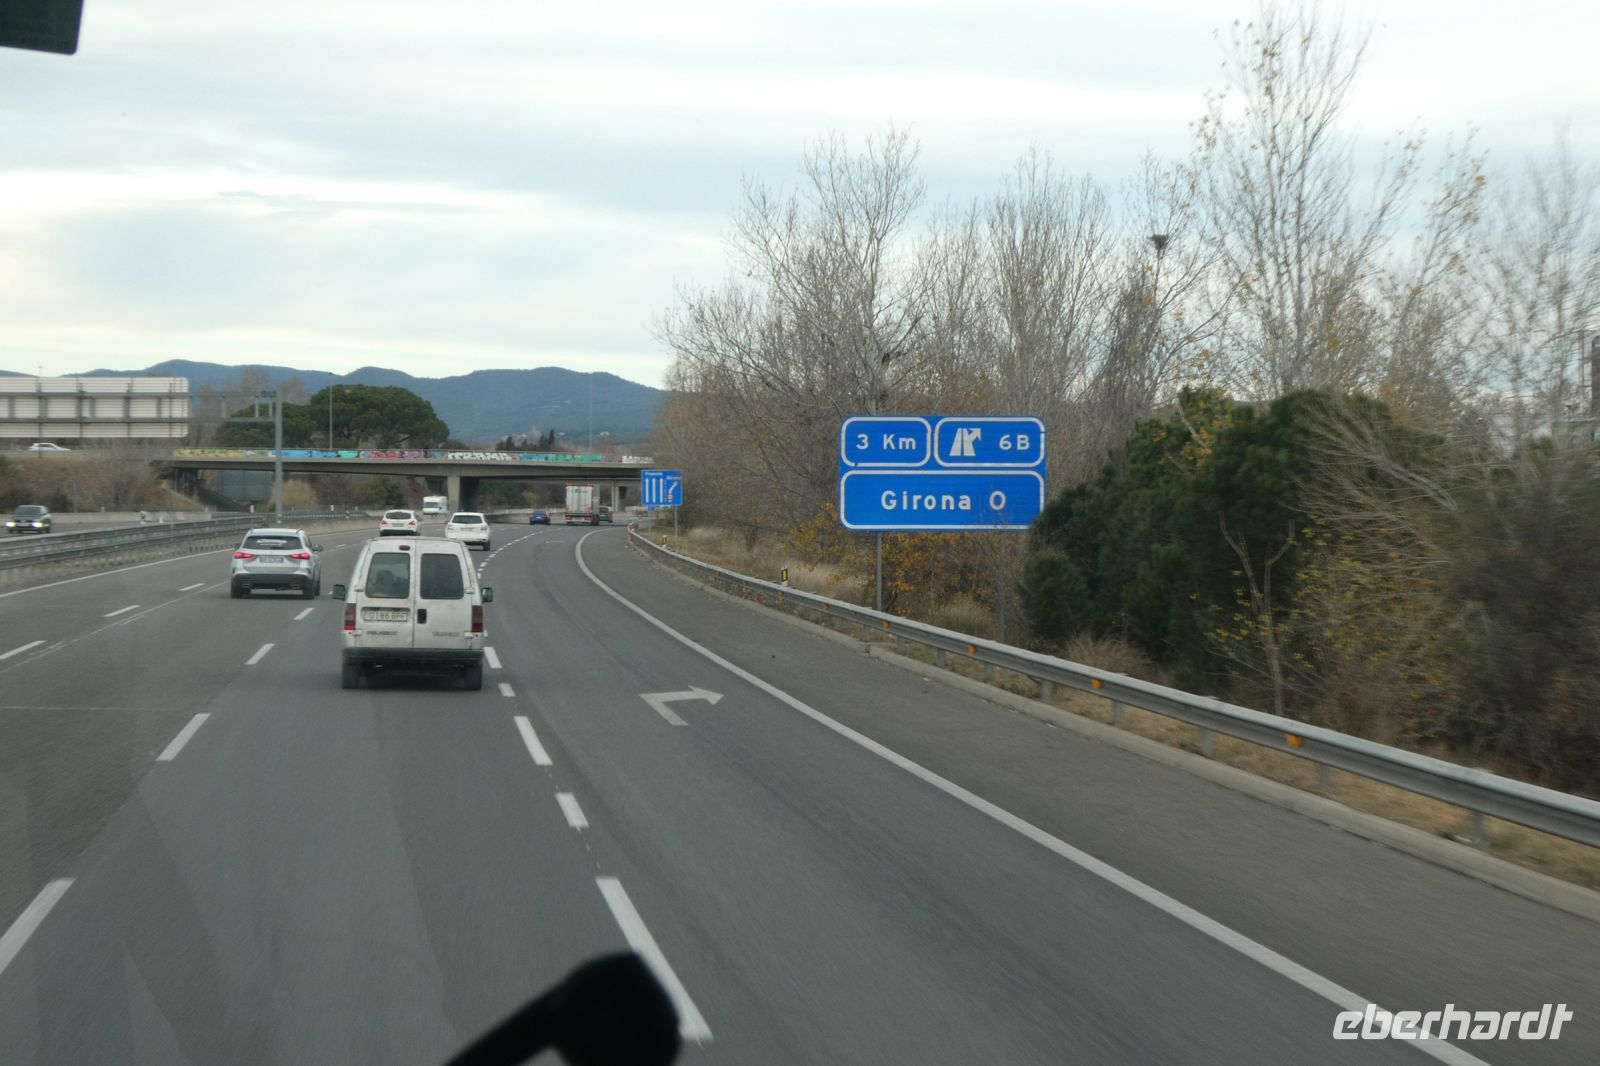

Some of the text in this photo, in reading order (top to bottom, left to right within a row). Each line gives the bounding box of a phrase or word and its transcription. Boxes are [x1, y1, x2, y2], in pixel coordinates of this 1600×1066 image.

[856, 433, 917, 450] 3 Km
[999, 434, 1030, 450] 6B
[881, 490, 971, 510] Girona
